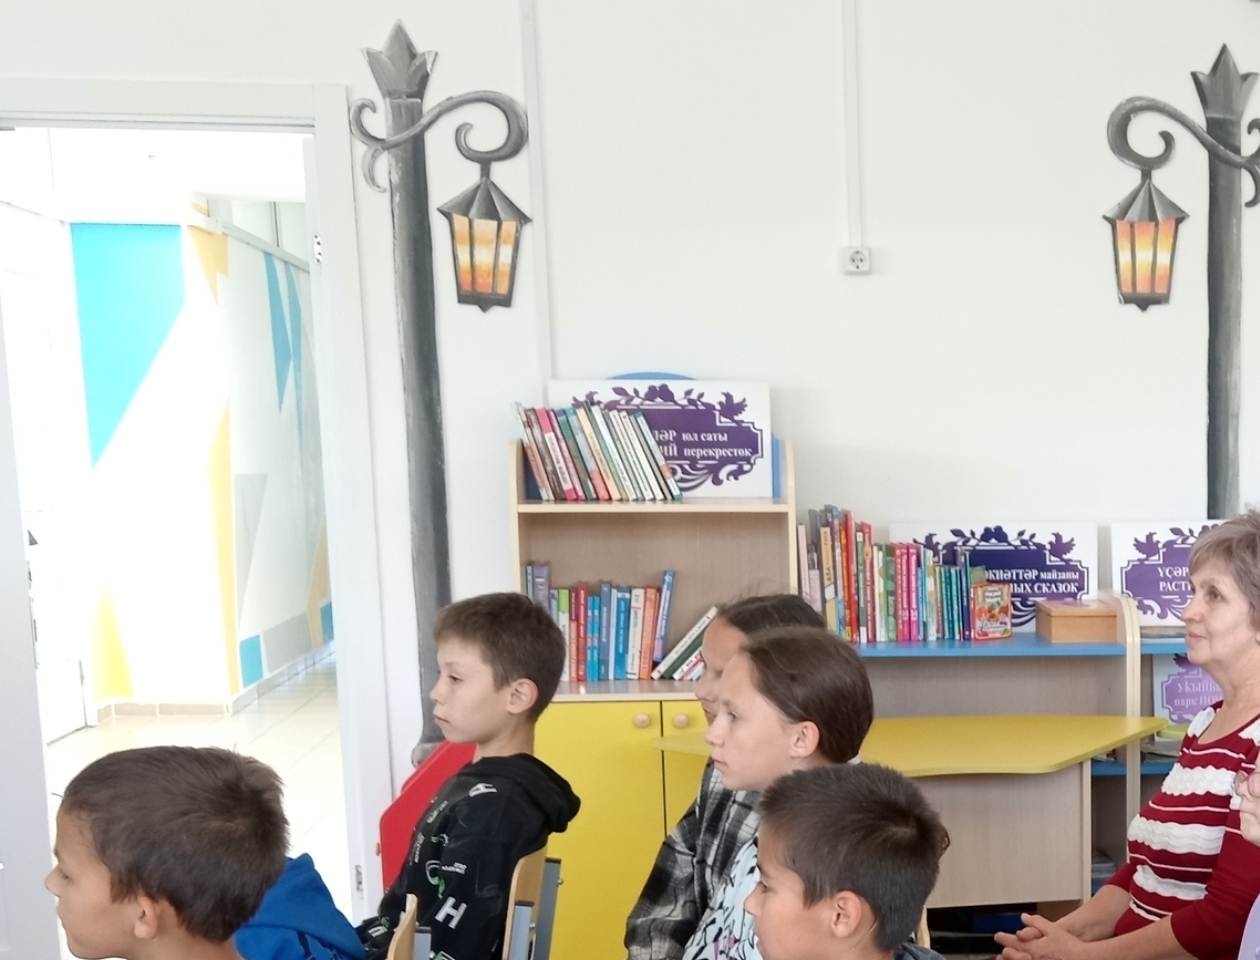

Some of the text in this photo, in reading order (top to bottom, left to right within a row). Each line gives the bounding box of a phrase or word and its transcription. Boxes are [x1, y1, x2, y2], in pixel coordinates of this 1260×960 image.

[701, 433, 728, 441] саты
[683, 447, 752, 459] перекресток
[1034, 583, 1079, 593] СКАЗОК
